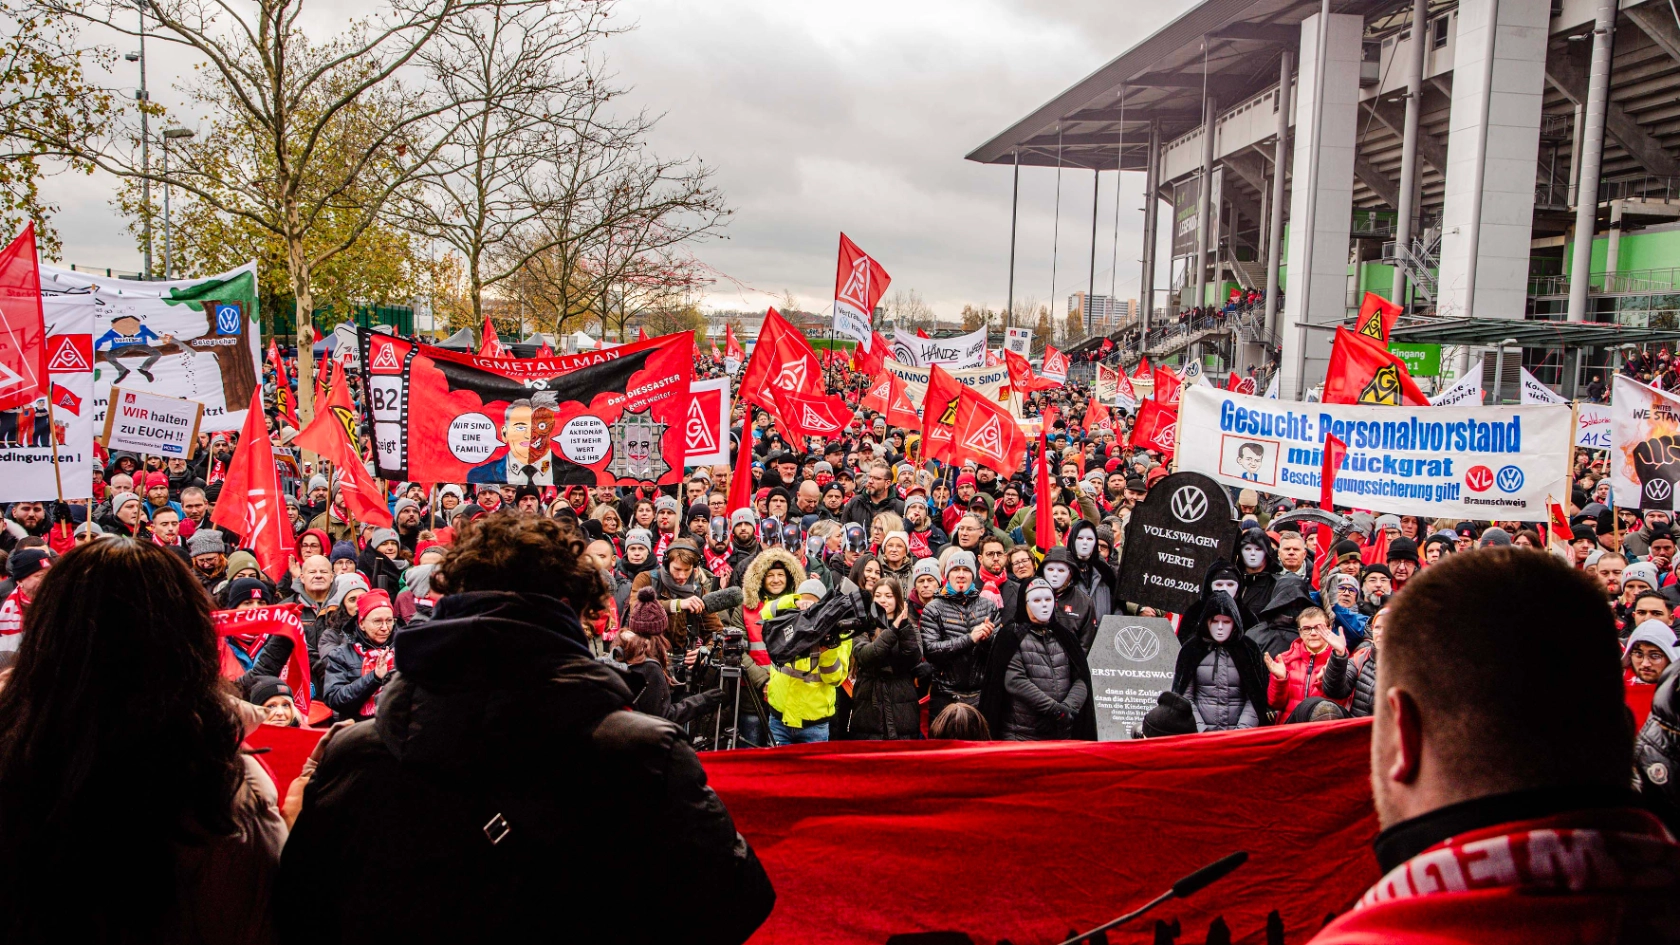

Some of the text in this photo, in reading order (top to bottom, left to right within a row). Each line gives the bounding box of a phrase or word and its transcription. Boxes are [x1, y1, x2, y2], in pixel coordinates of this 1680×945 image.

[921, 343, 960, 361] HÄNDE
[1391, 348, 1426, 360] Eingang
[472, 350, 620, 372] IGMETALLMAN
[1413, 362, 1419, 370] 1
[978, 373, 1001, 385] SIND
[607, 374, 680, 406] Das DIESSASTER
[373, 387, 398, 410] B2
[628, 399, 647, 411] geht
[1633, 409, 1651, 419] WE
[1652, 403, 1672, 411] UNITED
[123, 406, 188, 426] WIR halten
[120, 425, 135, 434] zu
[138, 426, 173, 440] EUCH
[452, 422, 492, 430] WIR SIND
[1220, 399, 1521, 453] Gesucht: Personalvorstand
[455, 445, 489, 453] FAMILIE
[1435, 482, 1461, 503] gilt!
[1464, 496, 1527, 508] Braunschweig
[1143, 524, 1220, 549] VOLKSWAGEN
[1157, 551, 1195, 568] WERTE
[1150, 575, 1200, 594] 02.09.2024
[234, 608, 269, 623] FÜR
[1091, 668, 1116, 677] ERST
[1125, 688, 1137, 696] die
